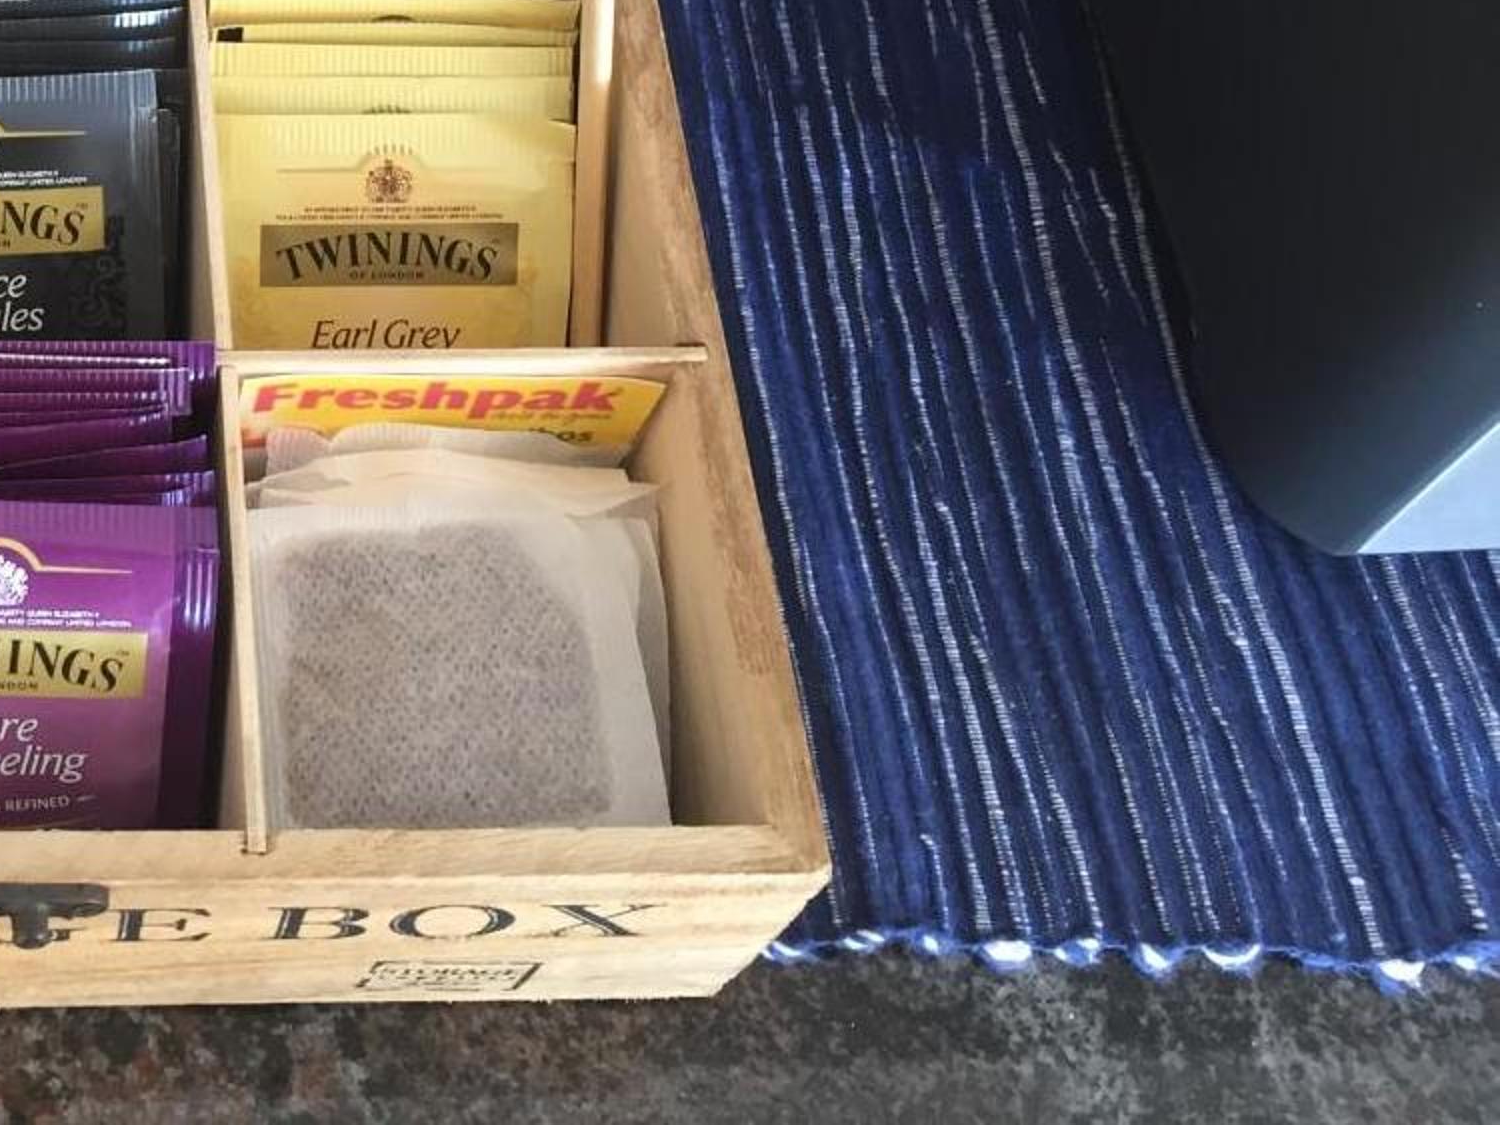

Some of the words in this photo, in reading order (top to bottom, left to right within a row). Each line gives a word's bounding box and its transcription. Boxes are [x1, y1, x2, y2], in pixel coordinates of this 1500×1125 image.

[275, 230, 499, 281] TWININGS
[311, 318, 378, 350] Earl
[252, 380, 617, 420] Freshpak
[5, 794, 71, 812] REFINED
[266, 903, 668, 941] BOX
